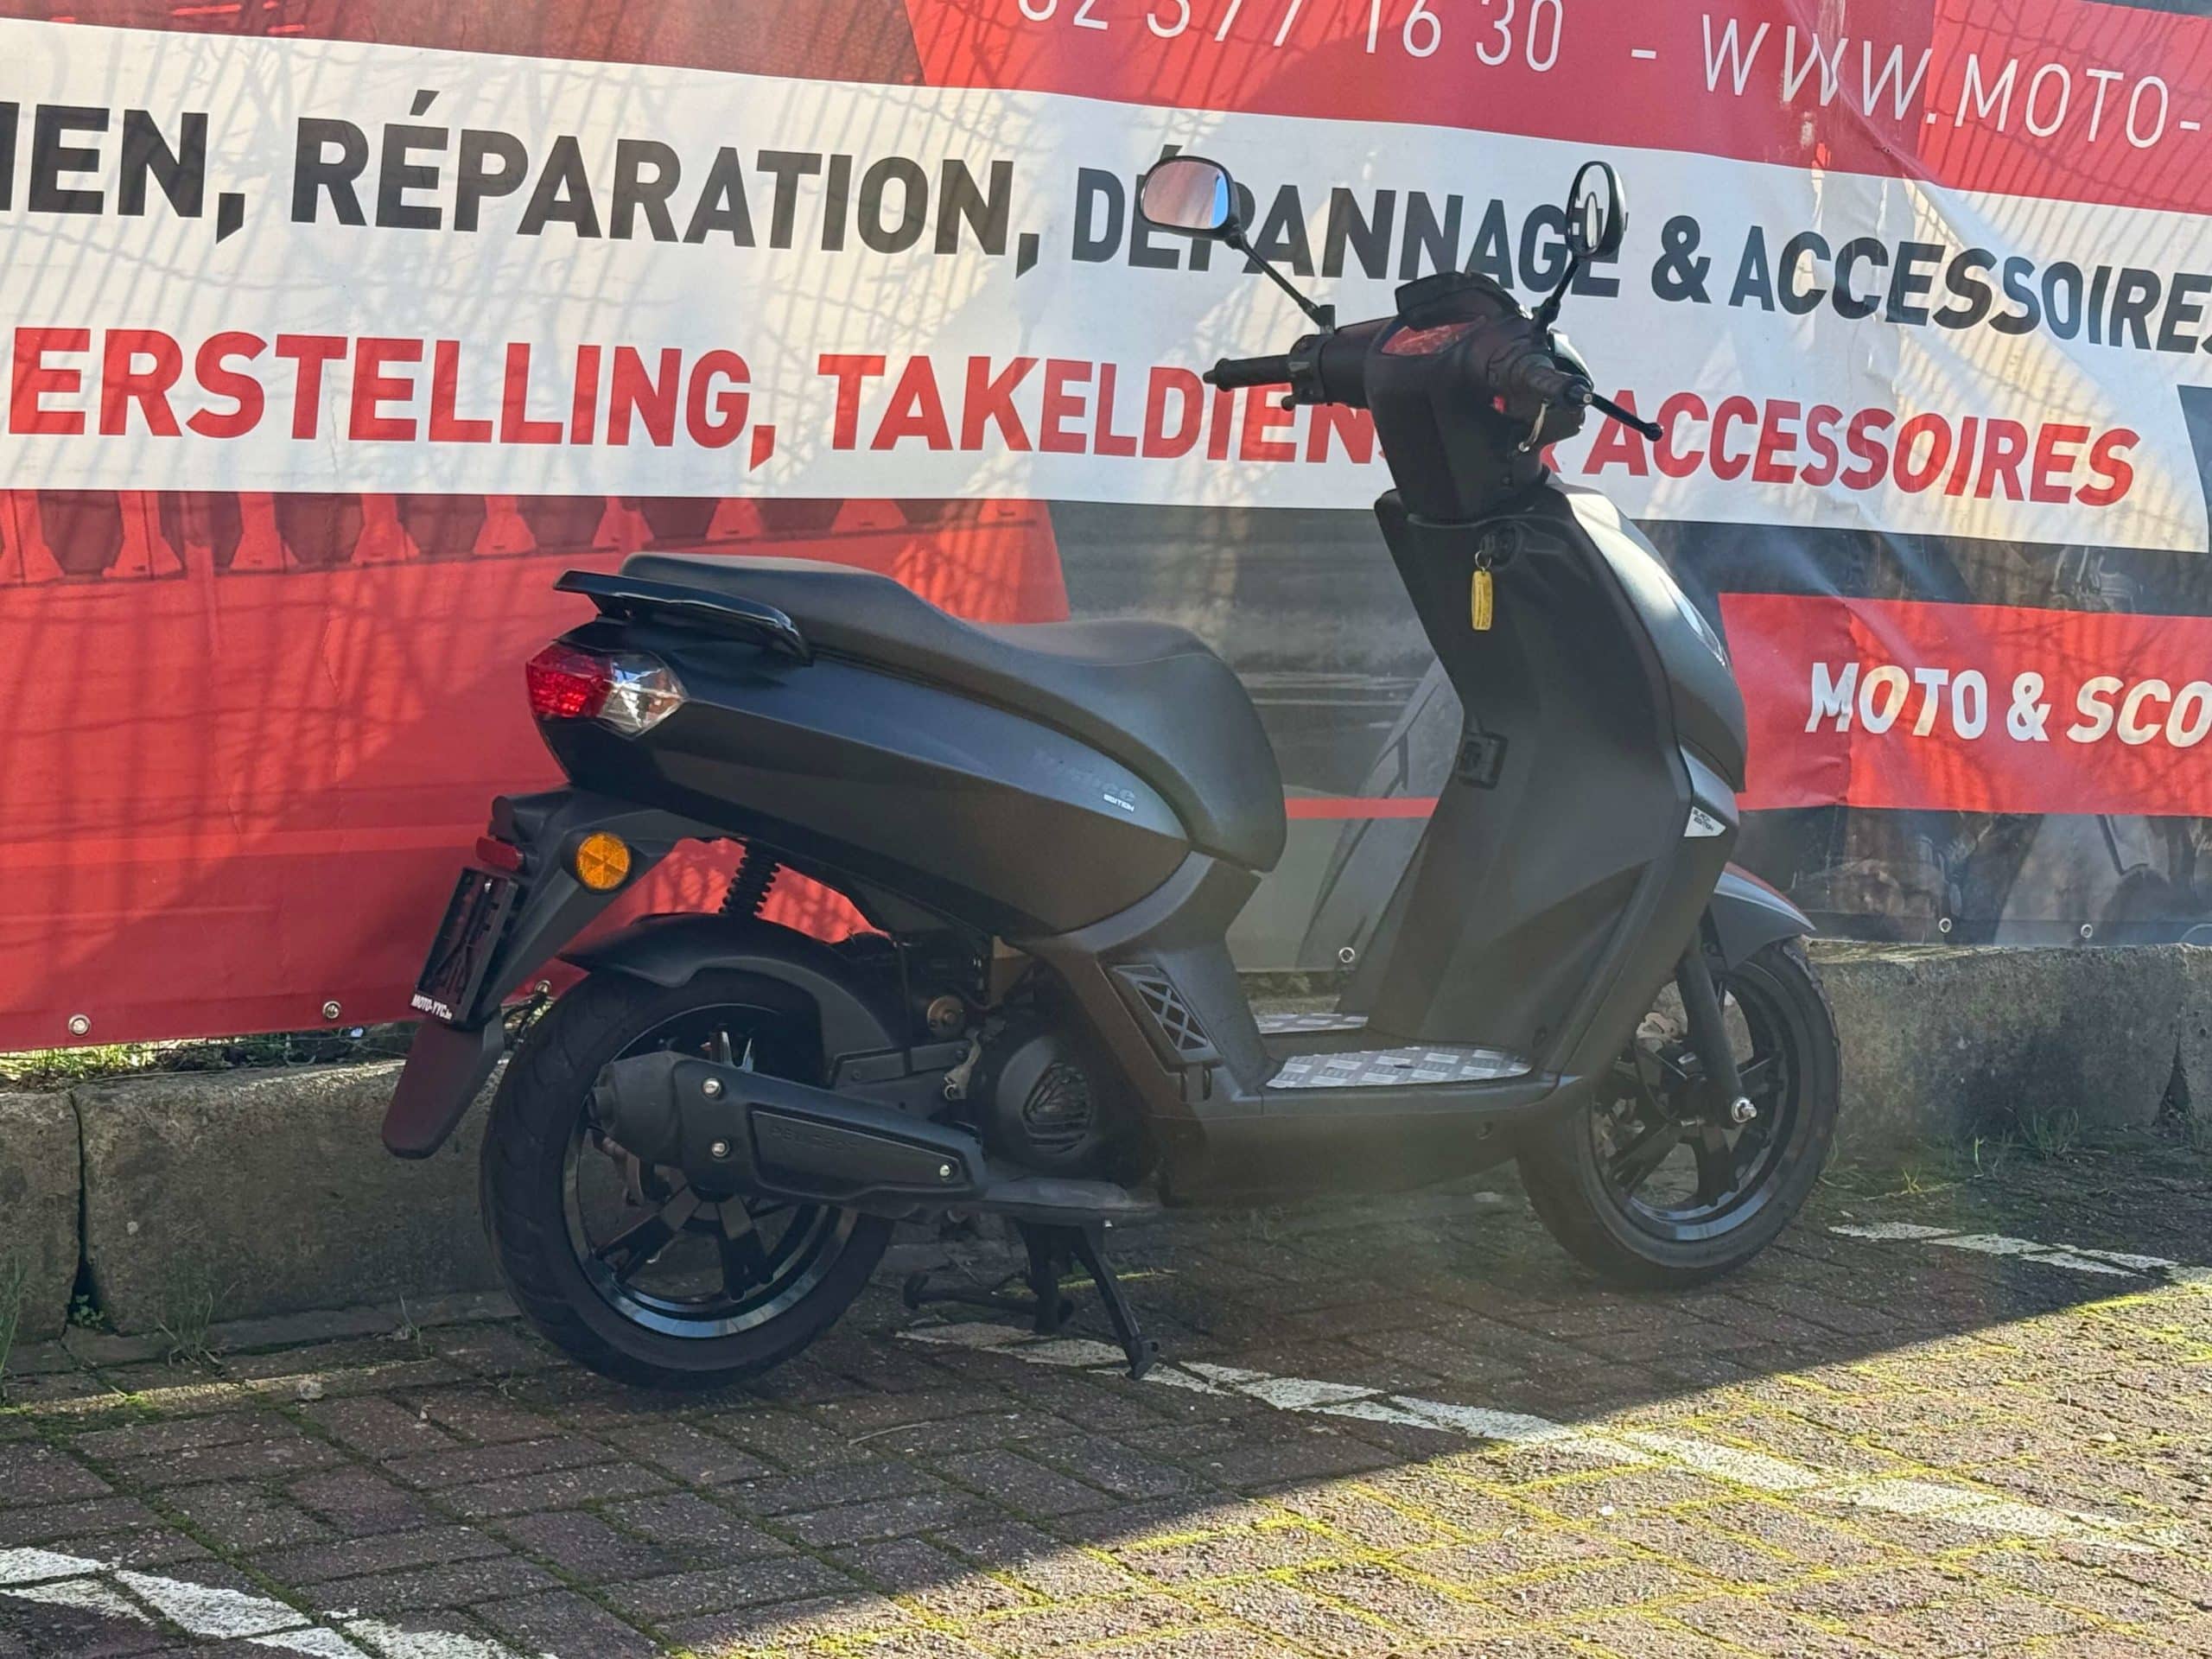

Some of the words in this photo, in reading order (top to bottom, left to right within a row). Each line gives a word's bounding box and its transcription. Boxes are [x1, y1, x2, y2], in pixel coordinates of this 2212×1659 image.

[1476, 0, 1563, 72] 30
[1702, 14, 2201, 149] WWW.MOTO-
[291, 90, 1039, 279] RÉPARATION,
[1651, 215, 1712, 303] &
[1729, 226, 2212, 354] ACCESSOIRE
[9, 327, 775, 472] ERSTELLING,
[817, 354, 1386, 464] TAKELDIEN
[1582, 390, 2140, 506] ACCESSOIRES
[1805, 662, 1986, 740] MOTO
[2006, 671, 2051, 742] &
[2066, 676, 2212, 747] SCO
